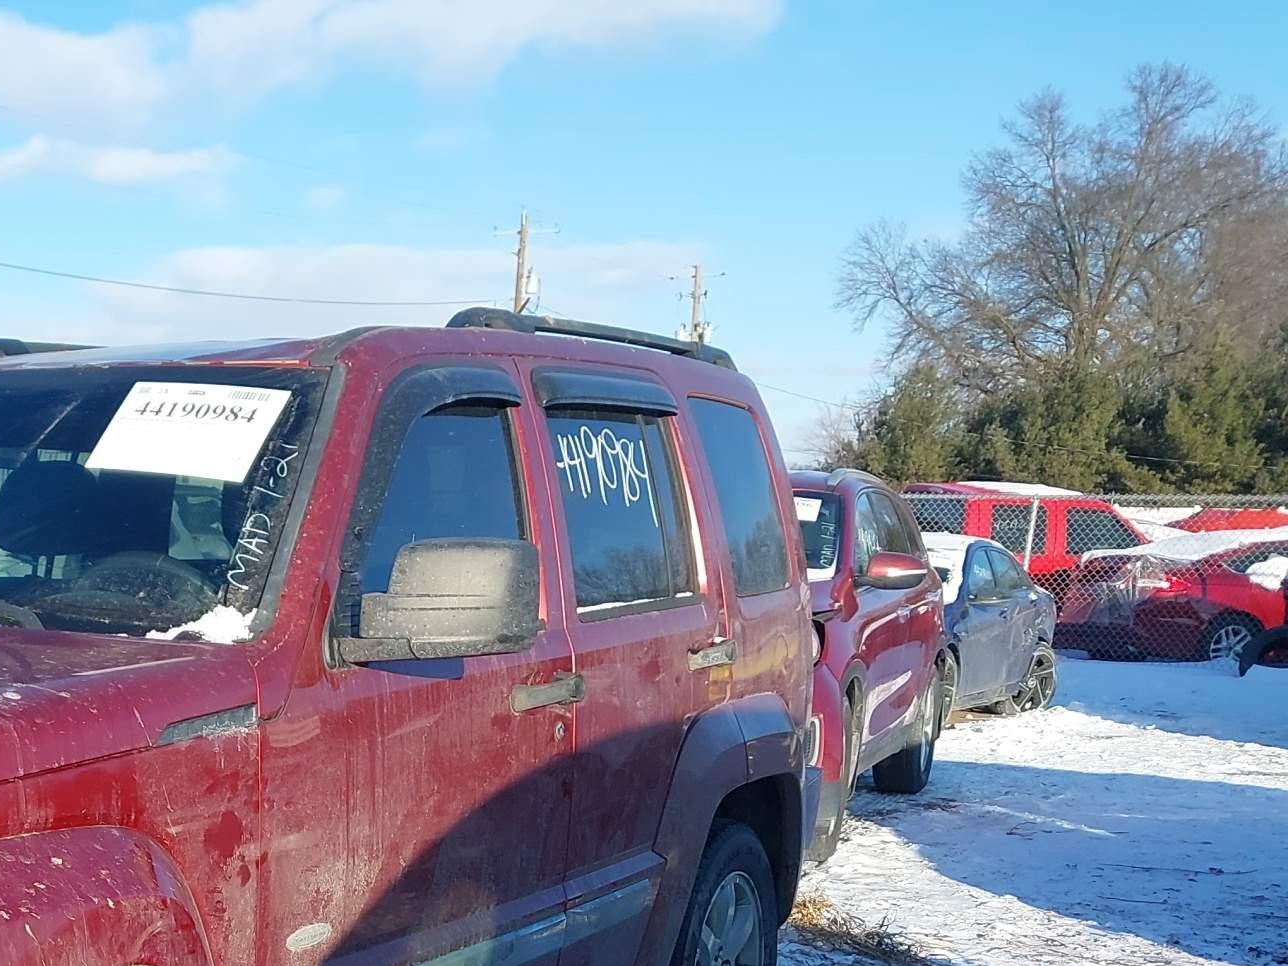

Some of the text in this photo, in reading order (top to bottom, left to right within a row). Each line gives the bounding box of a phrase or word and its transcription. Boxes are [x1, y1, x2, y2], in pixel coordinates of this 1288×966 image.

[134, 400, 259, 424] 44190984
[226, 440, 299, 590] MAD 1-21
[556, 425, 659, 528] 44190984
